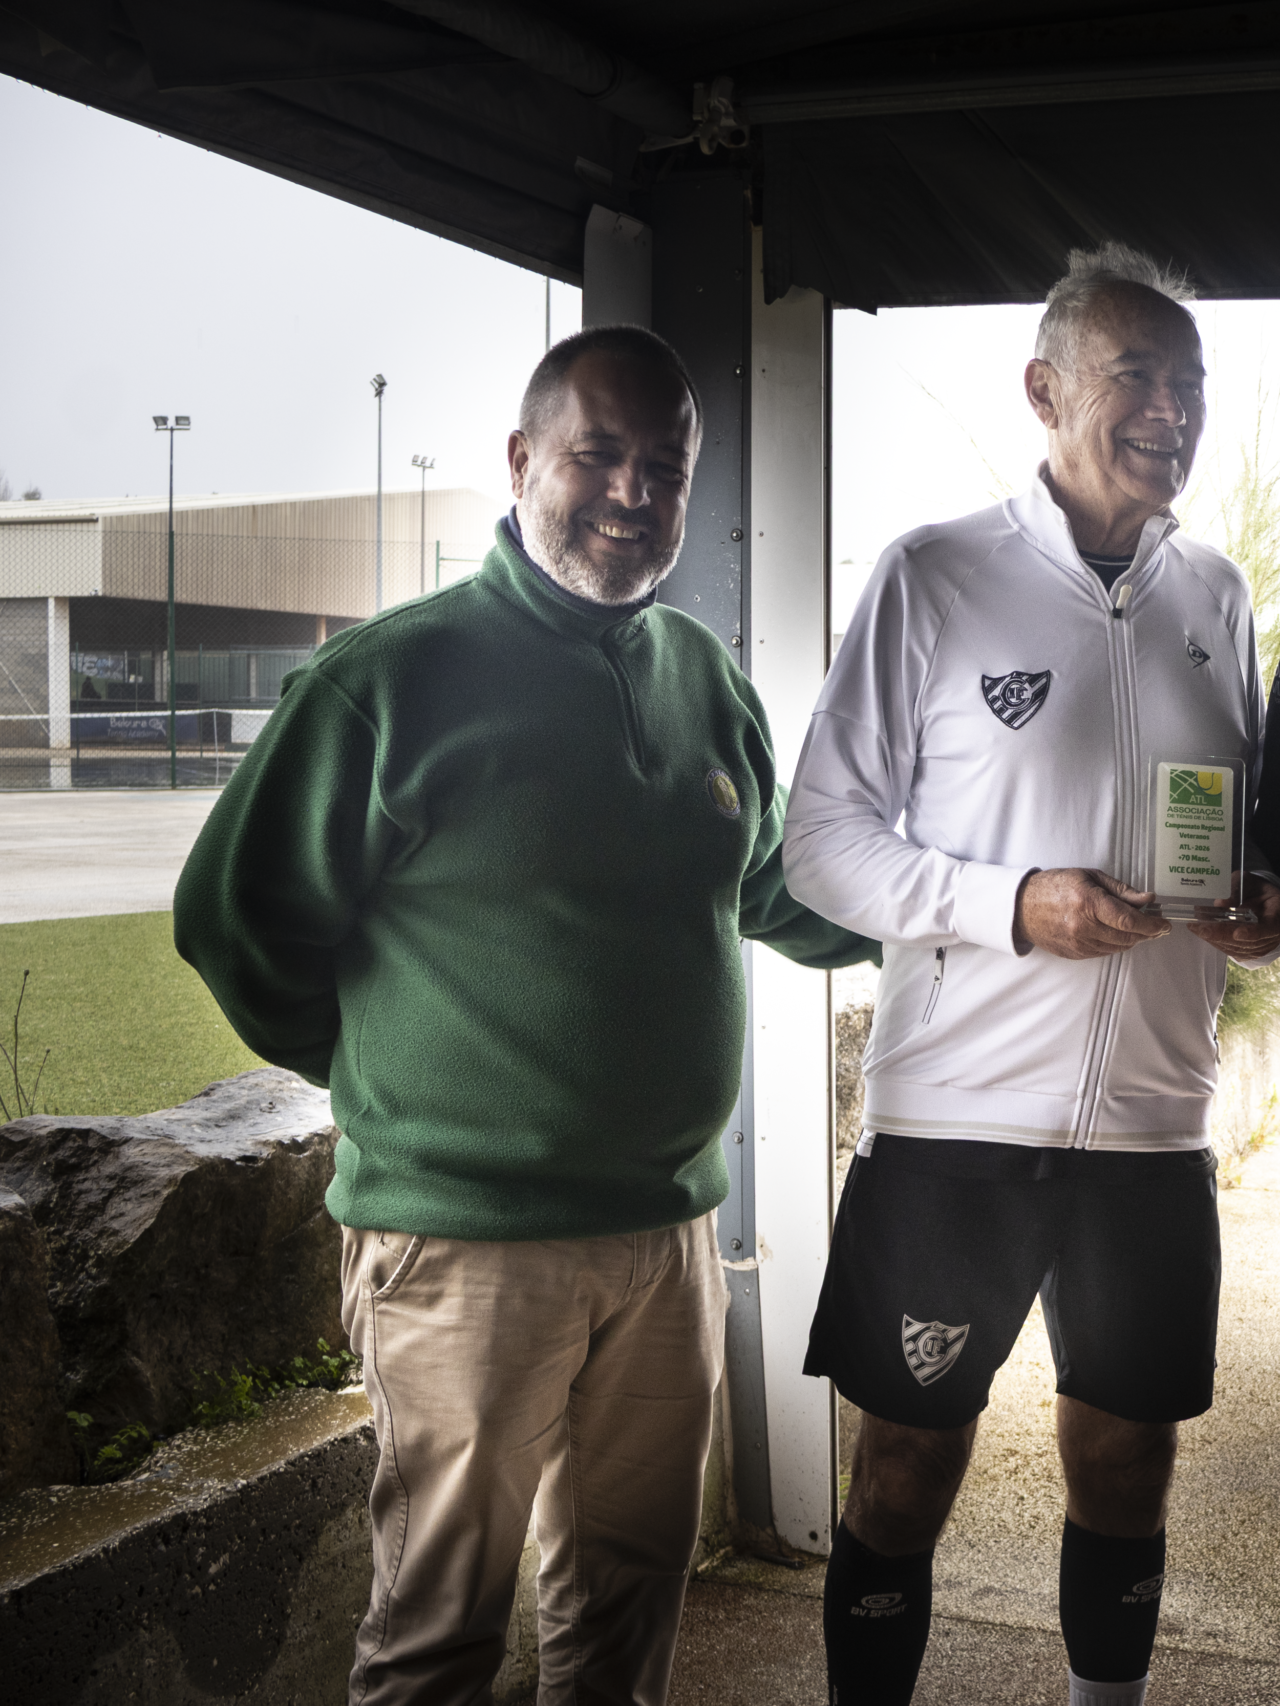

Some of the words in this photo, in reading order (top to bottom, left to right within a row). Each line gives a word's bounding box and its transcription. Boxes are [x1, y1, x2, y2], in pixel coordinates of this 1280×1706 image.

[1189, 794, 1208, 805] ATL
[1167, 805, 1224, 816] ASSOCIAÇÃO
[1165, 821, 1200, 830] Campeonato
[1201, 824, 1226, 832] Regional
[1179, 832, 1210, 840] Veteranos
[1191, 854, 1210, 862] Masc.
[1168, 865, 1185, 873] VICE
[1186, 865, 1220, 875] CAMPEÃO
[1140, 1590, 1163, 1603] SPO
[850, 1606, 867, 1617] BV
[869, 1603, 908, 1618] SPORT
